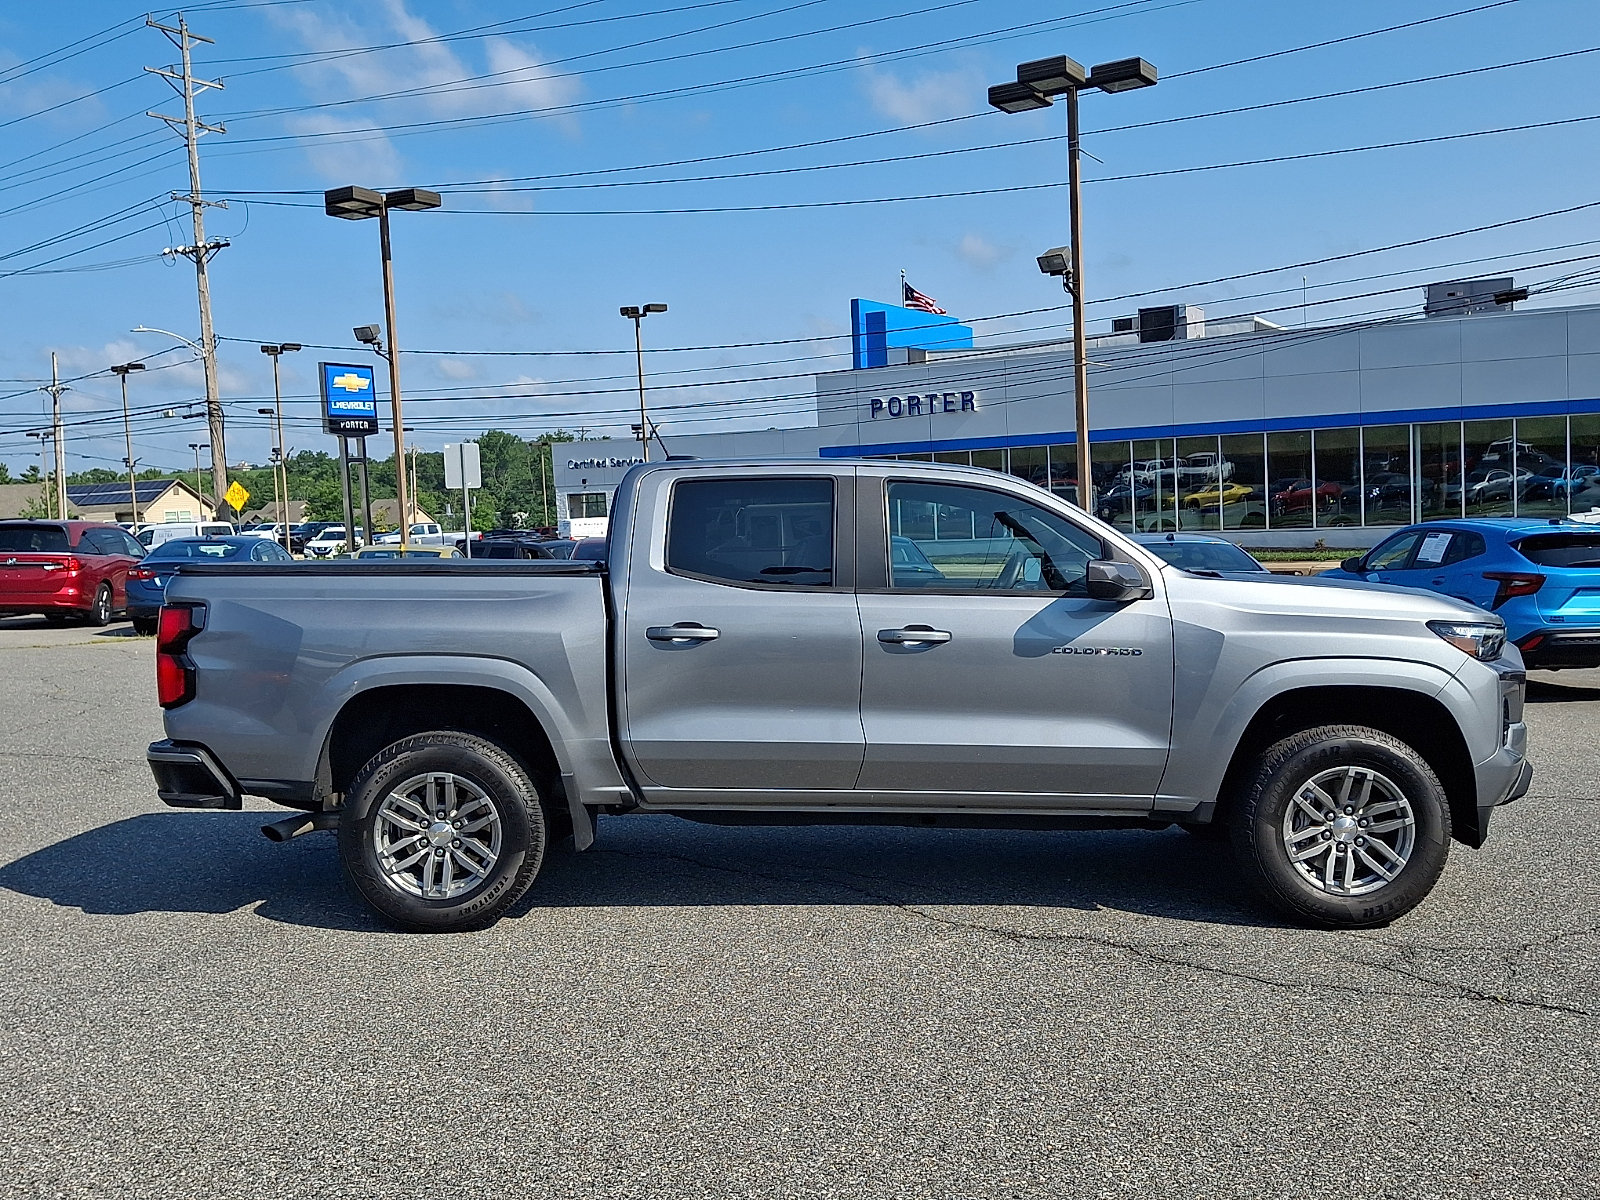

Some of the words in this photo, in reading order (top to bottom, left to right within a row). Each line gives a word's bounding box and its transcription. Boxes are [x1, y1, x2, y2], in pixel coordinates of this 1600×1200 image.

[331, 401, 374, 411] CHEVROLET
[870, 391, 976, 418] PORTER
[340, 420, 369, 429] PORTER
[567, 456, 607, 469] Certified
[610, 456, 644, 468] Service
[1052, 647, 1142, 656] COLORADO
